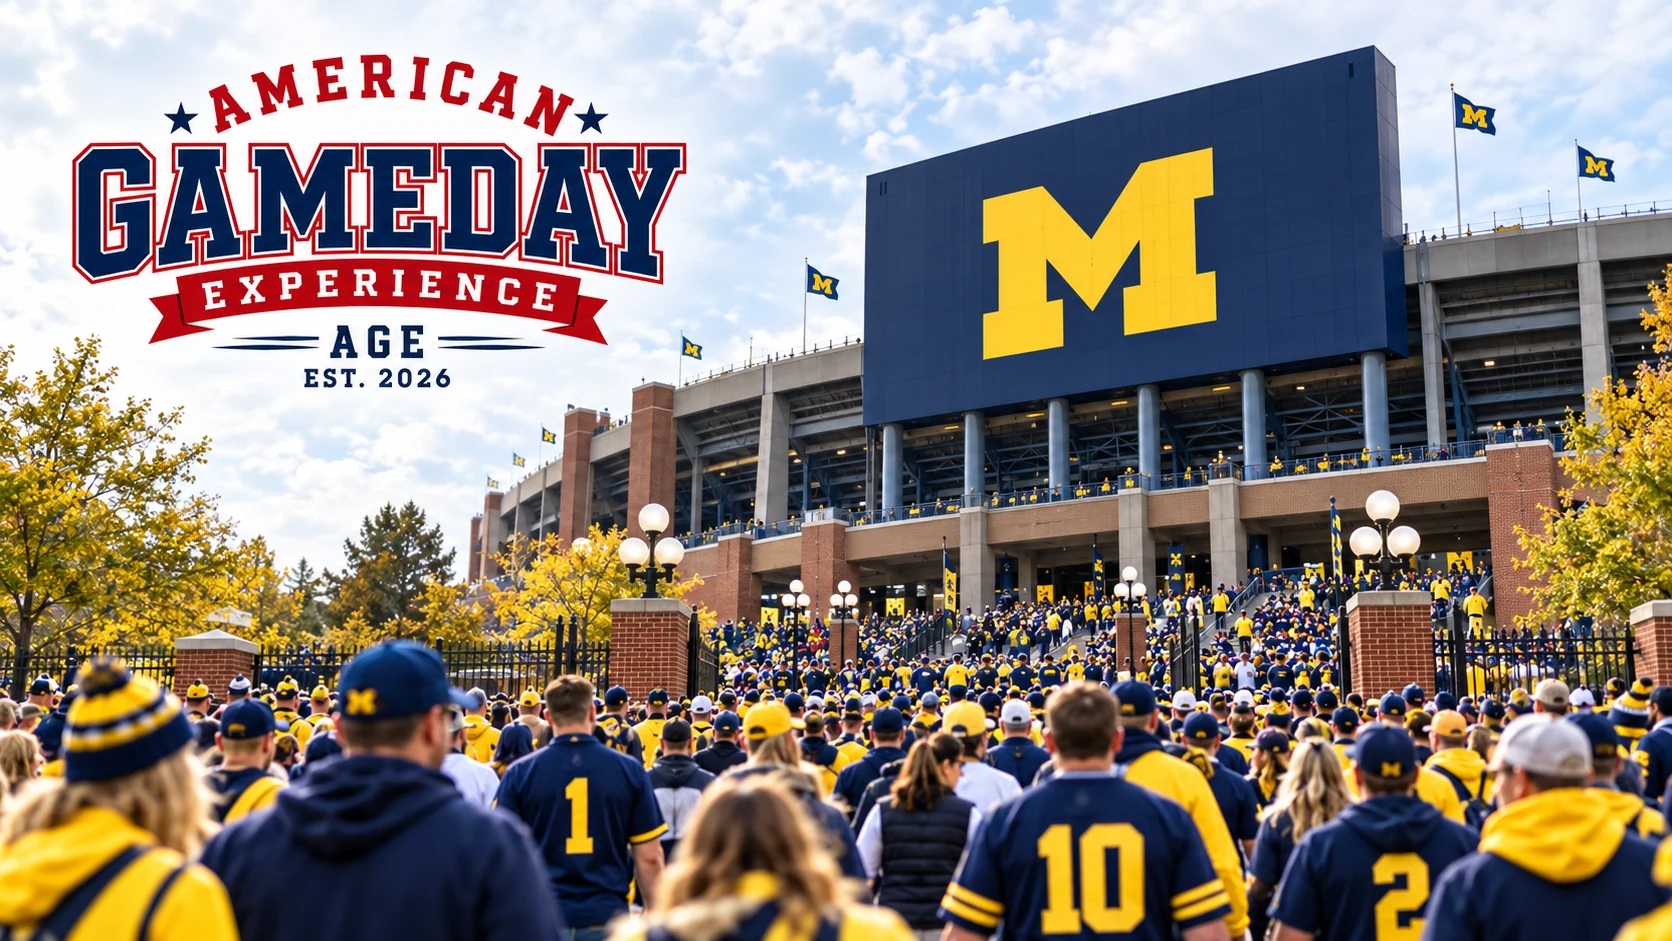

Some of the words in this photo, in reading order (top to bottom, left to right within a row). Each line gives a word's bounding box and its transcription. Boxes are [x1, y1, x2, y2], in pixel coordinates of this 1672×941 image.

[1462, 103, 1488, 128] M
[1585, 155, 1609, 177] M
[982, 147, 1217, 360] M
[812, 273, 833, 295] M
[684, 342, 699, 357] M
[564, 777, 594, 855] 1
[1037, 822, 1145, 935] 10
[1372, 852, 1430, 941] 2
